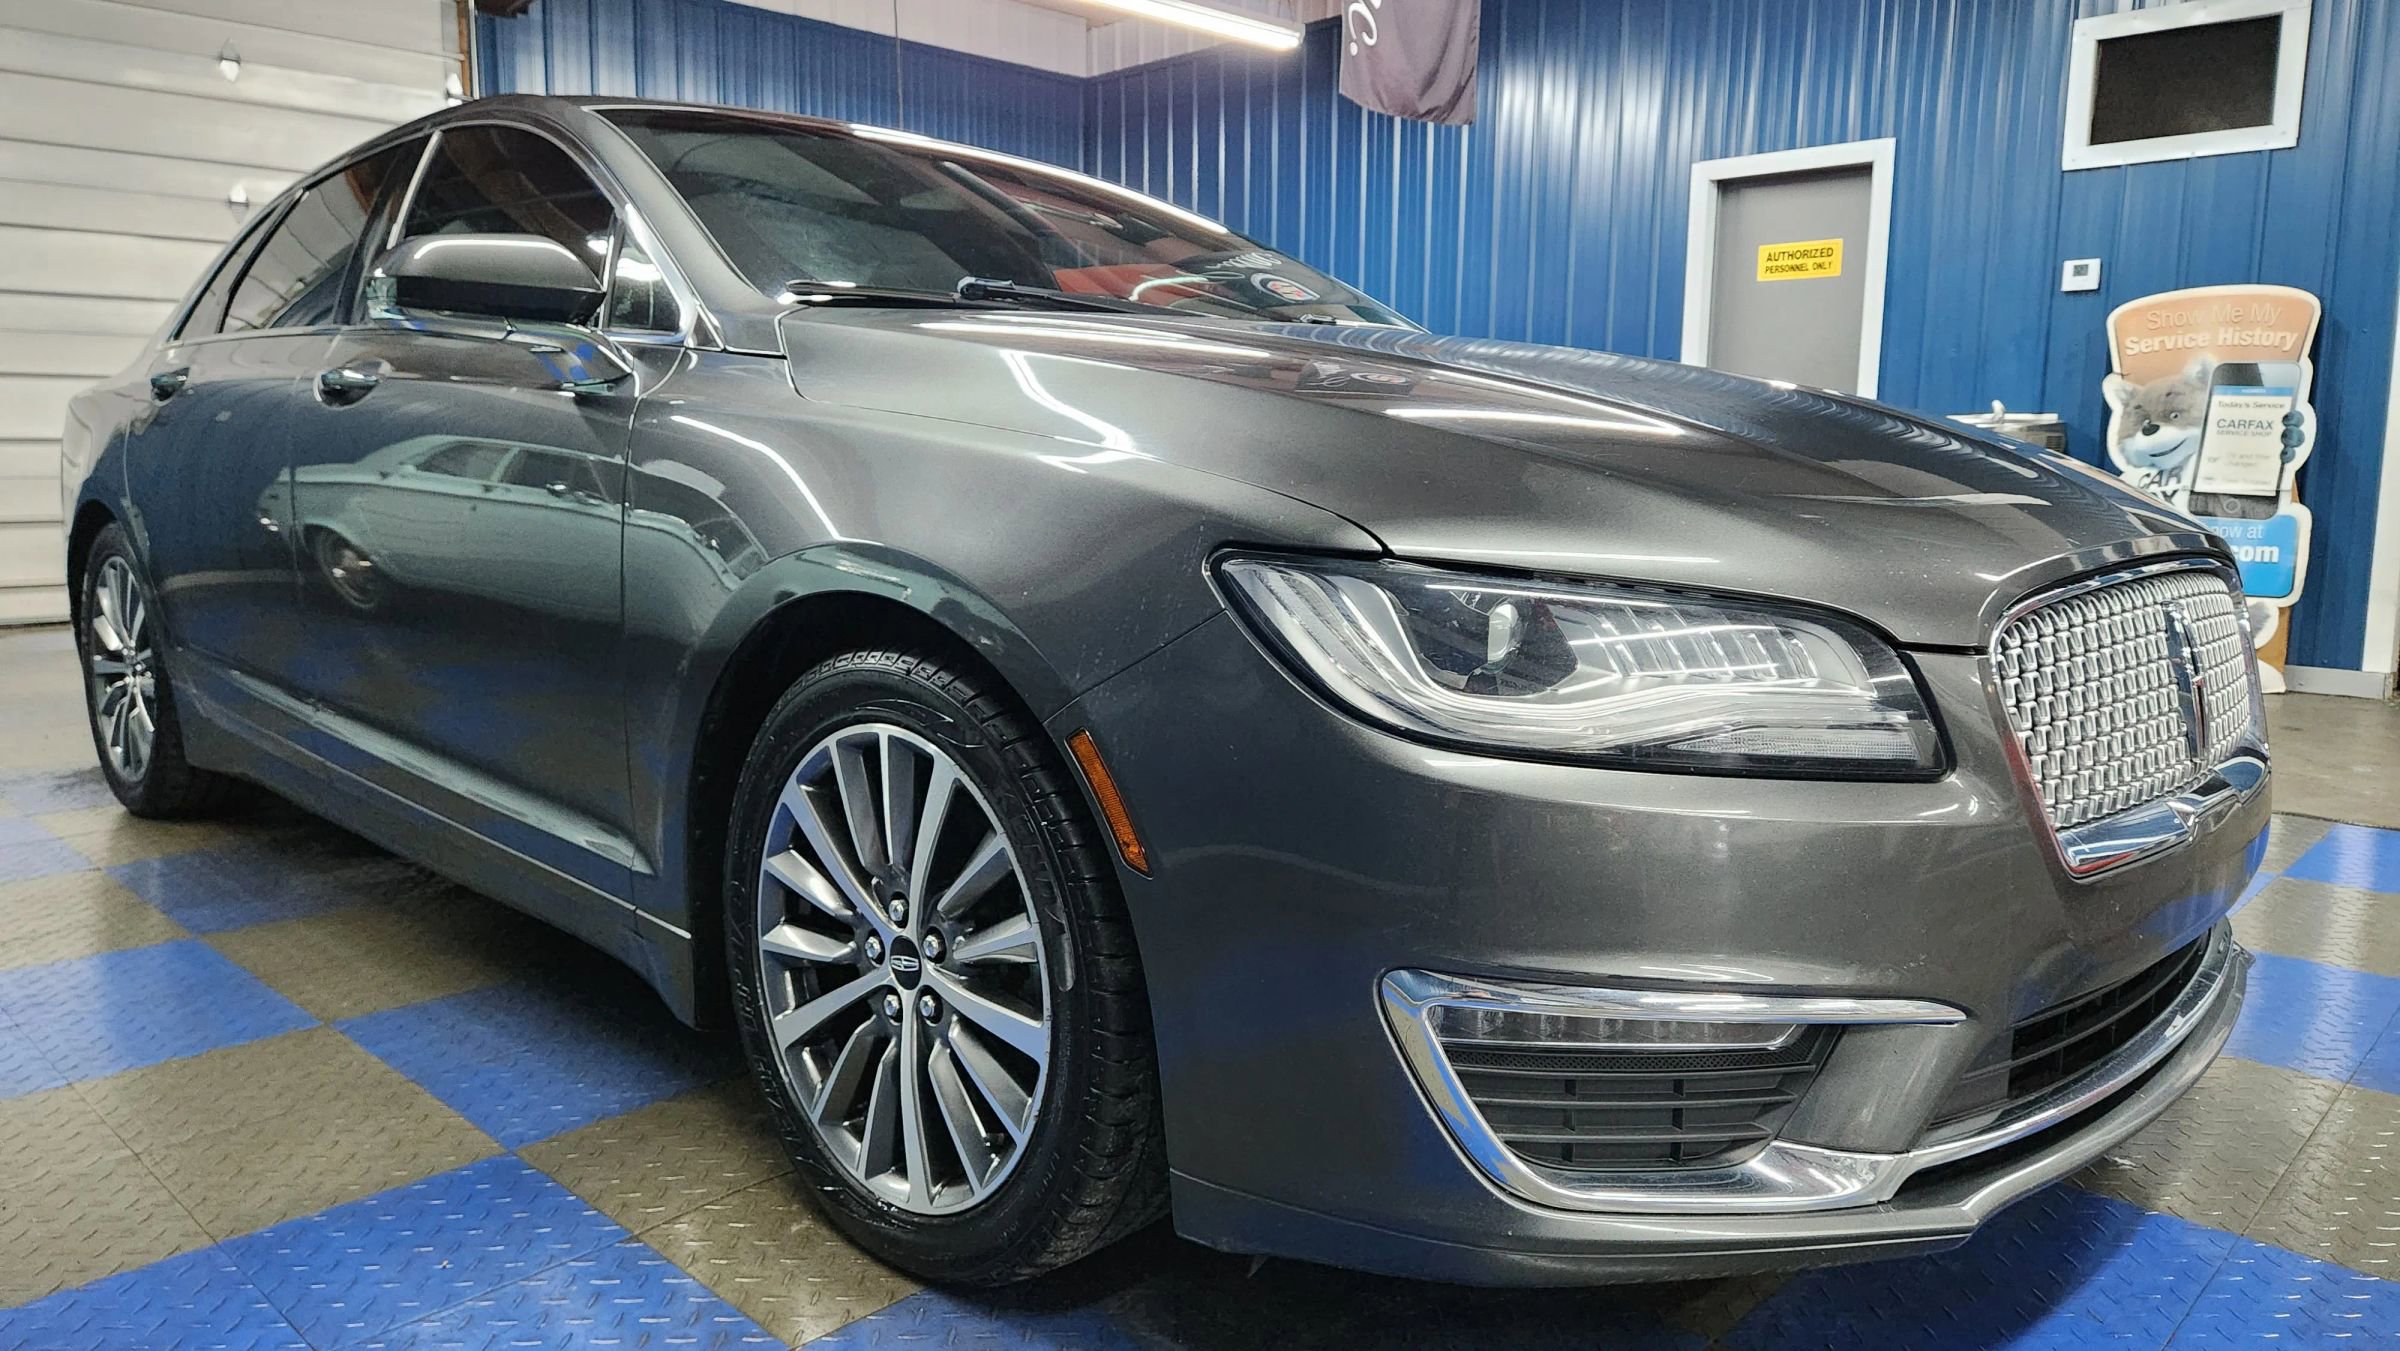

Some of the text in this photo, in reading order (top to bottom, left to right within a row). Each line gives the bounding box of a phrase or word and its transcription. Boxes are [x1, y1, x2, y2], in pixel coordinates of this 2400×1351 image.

[1766, 247, 1834, 262] AUTHORIZED
[1765, 261, 1832, 274] PERSONNEL ONLY
[2147, 302, 2281, 330] Show Me My
[2125, 327, 2298, 356] Service History
[2252, 401, 2286, 409] Service
[2216, 418, 2274, 430] CARFAX
[2138, 465, 2183, 489] CAR
[2246, 523, 2265, 539] at
